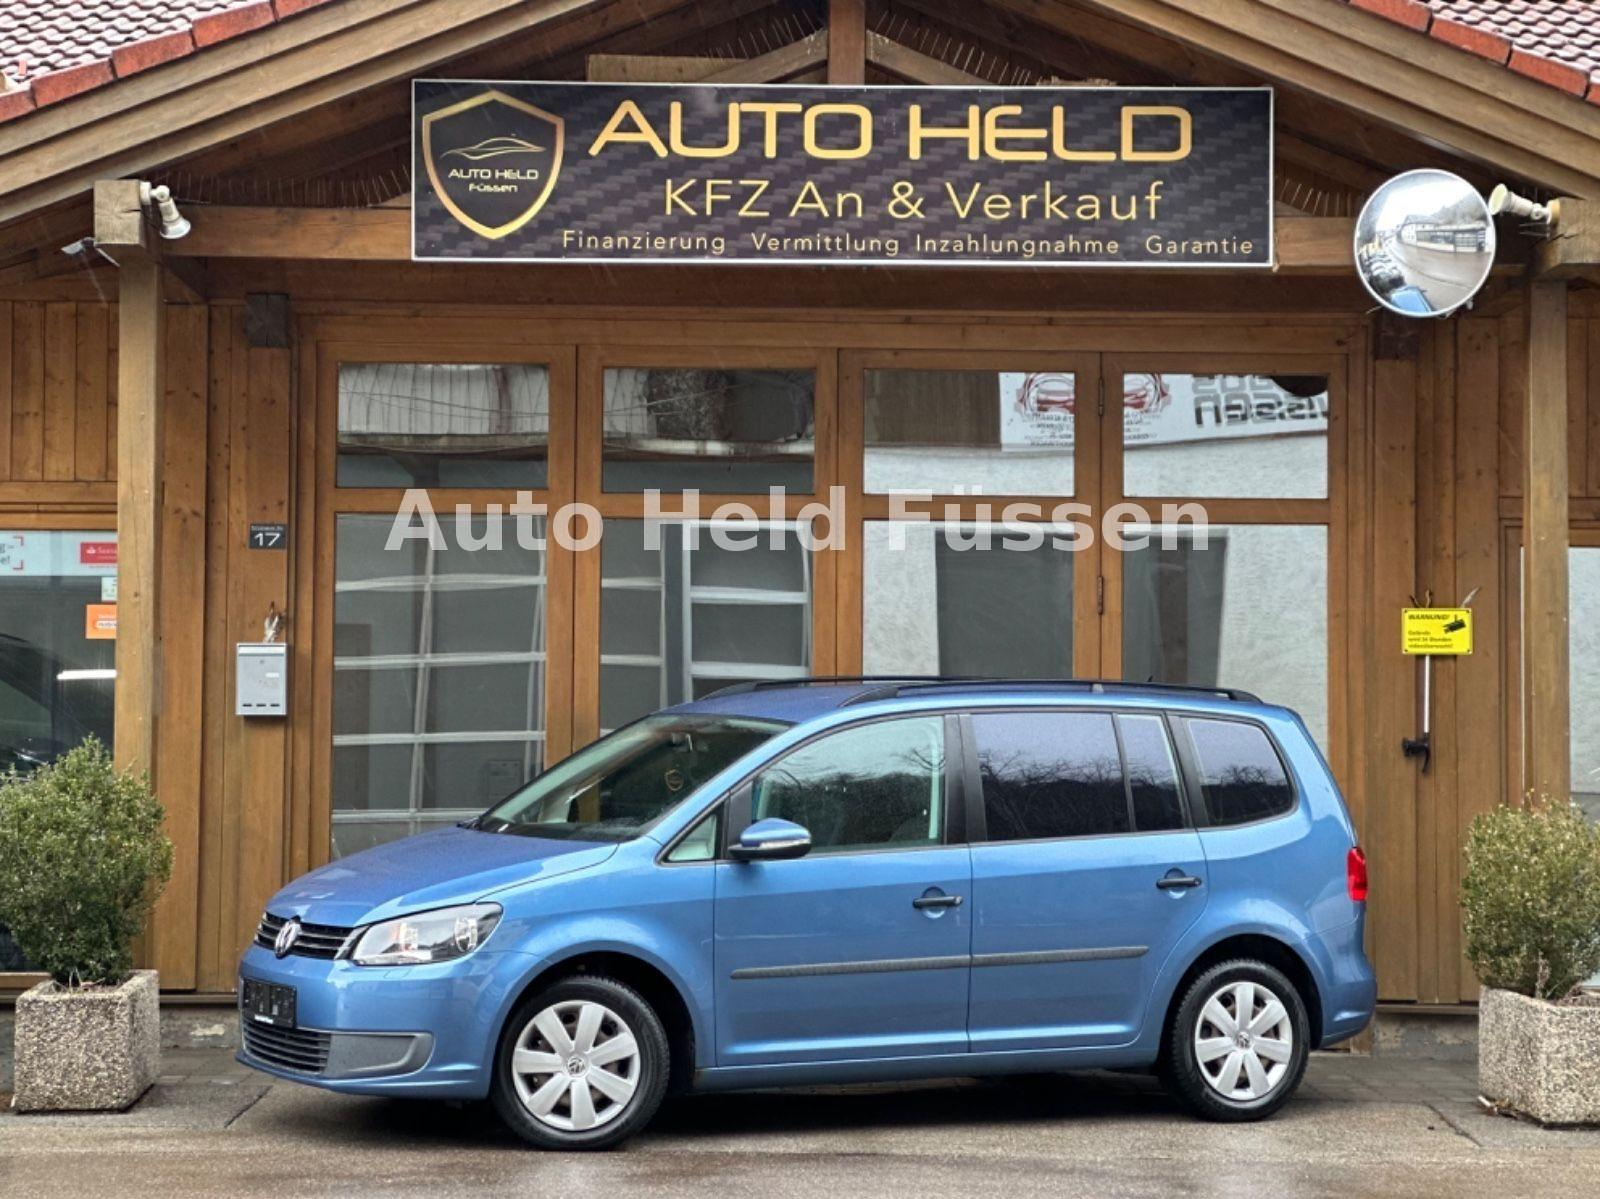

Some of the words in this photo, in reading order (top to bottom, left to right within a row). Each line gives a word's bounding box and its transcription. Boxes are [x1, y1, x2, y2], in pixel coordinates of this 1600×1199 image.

[587, 99, 874, 160] AUTO
[908, 104, 1193, 162] HELD
[448, 168, 492, 180] AUTO
[494, 168, 540, 180] HELD
[664, 177, 770, 217] KFZ
[788, 180, 864, 218] An
[887, 180, 926, 220] &
[944, 179, 1165, 221] Verkauf
[562, 229, 726, 255] Finanzierung
[750, 231, 900, 256] Vermittlung
[915, 233, 1120, 257] Inzahlungnahme
[1145, 234, 1254, 256] Garantie
[254, 532, 281, 547] 17
